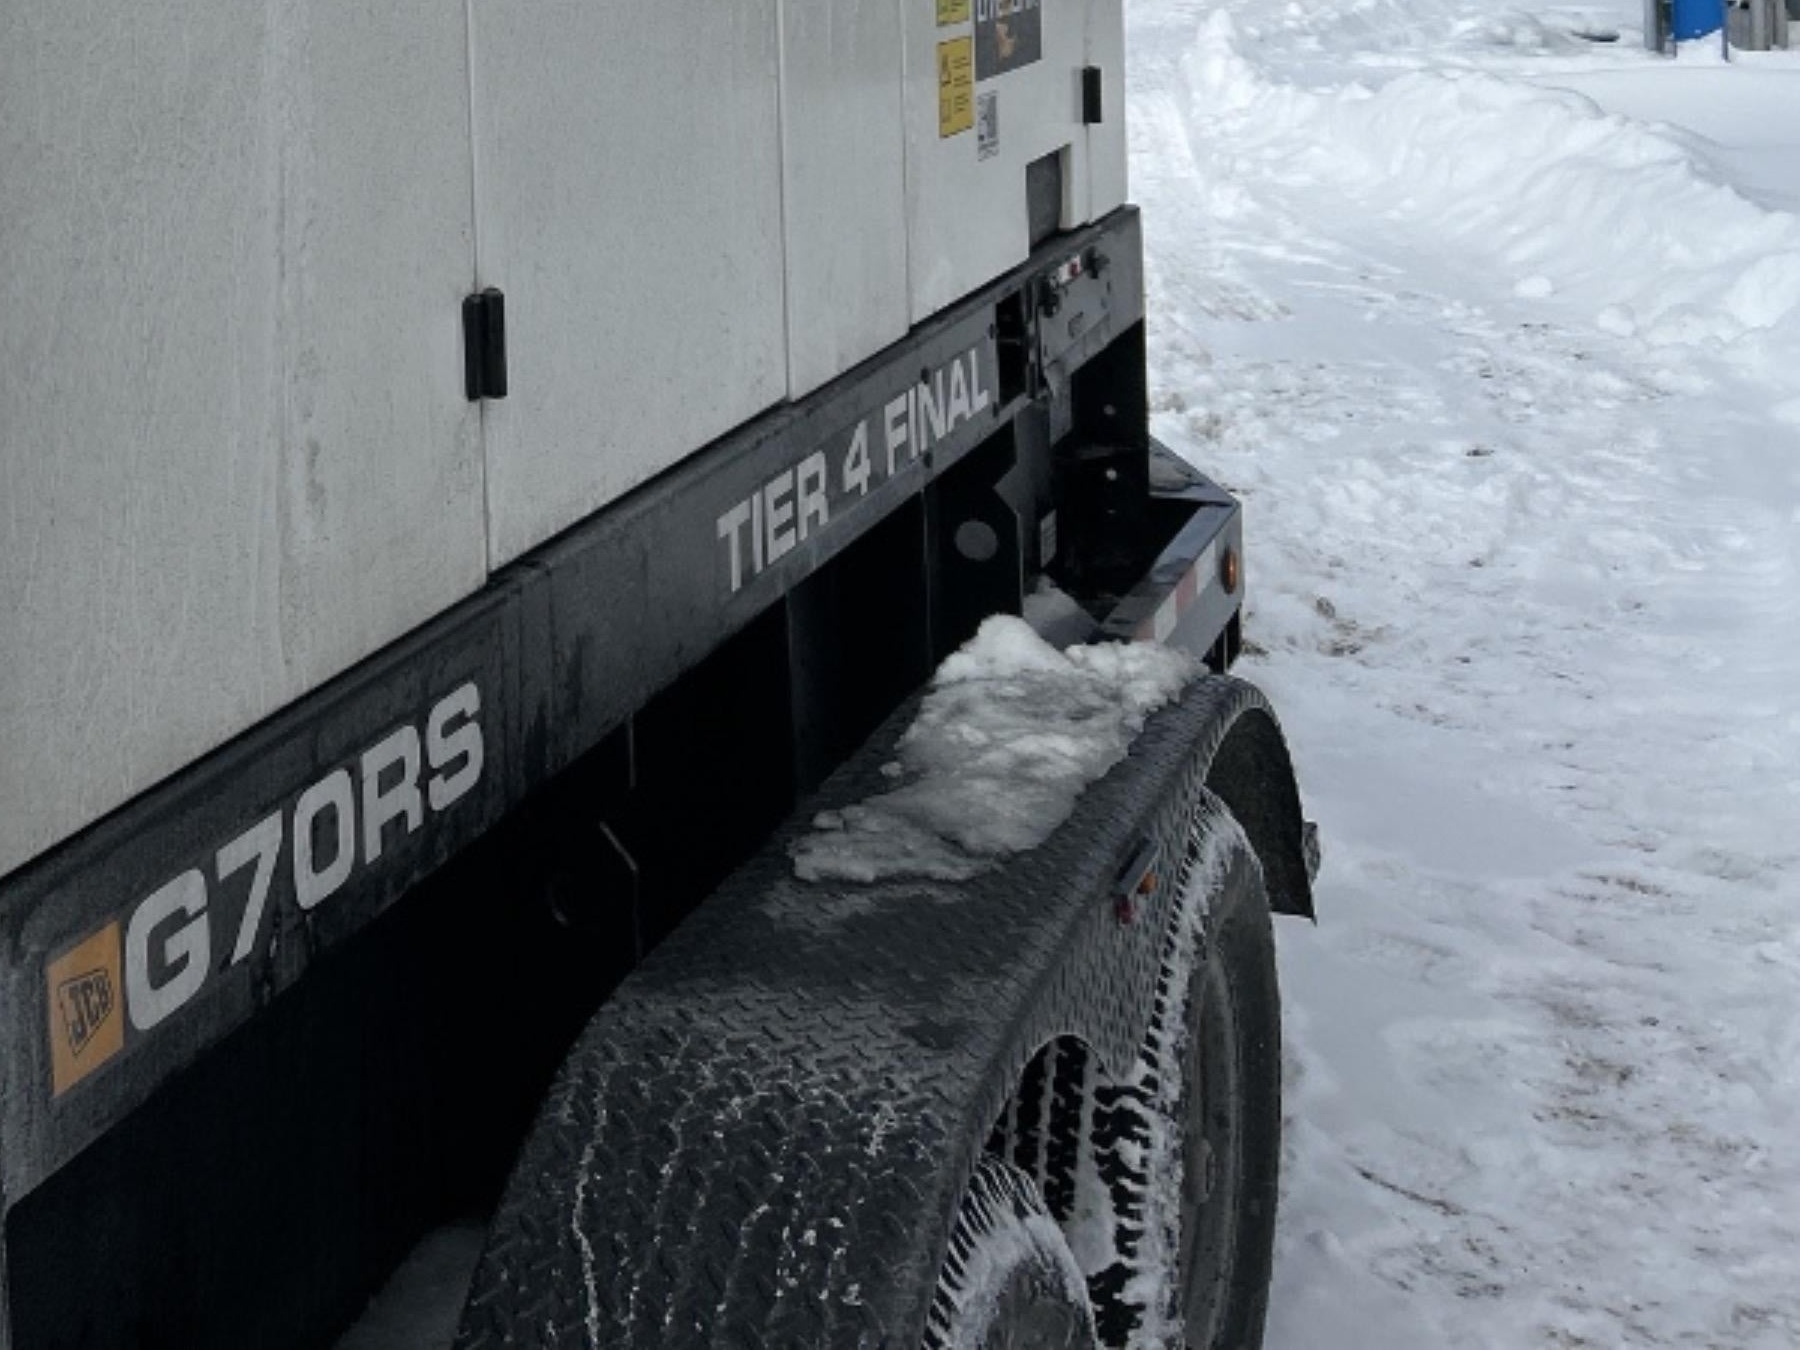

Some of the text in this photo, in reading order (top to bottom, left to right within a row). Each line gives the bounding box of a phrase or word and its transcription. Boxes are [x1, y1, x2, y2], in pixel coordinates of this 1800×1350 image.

[716, 350, 990, 592] TIER 4 FINAL
[125, 681, 485, 1031] G70RS
[67, 972, 114, 1044] JCB
